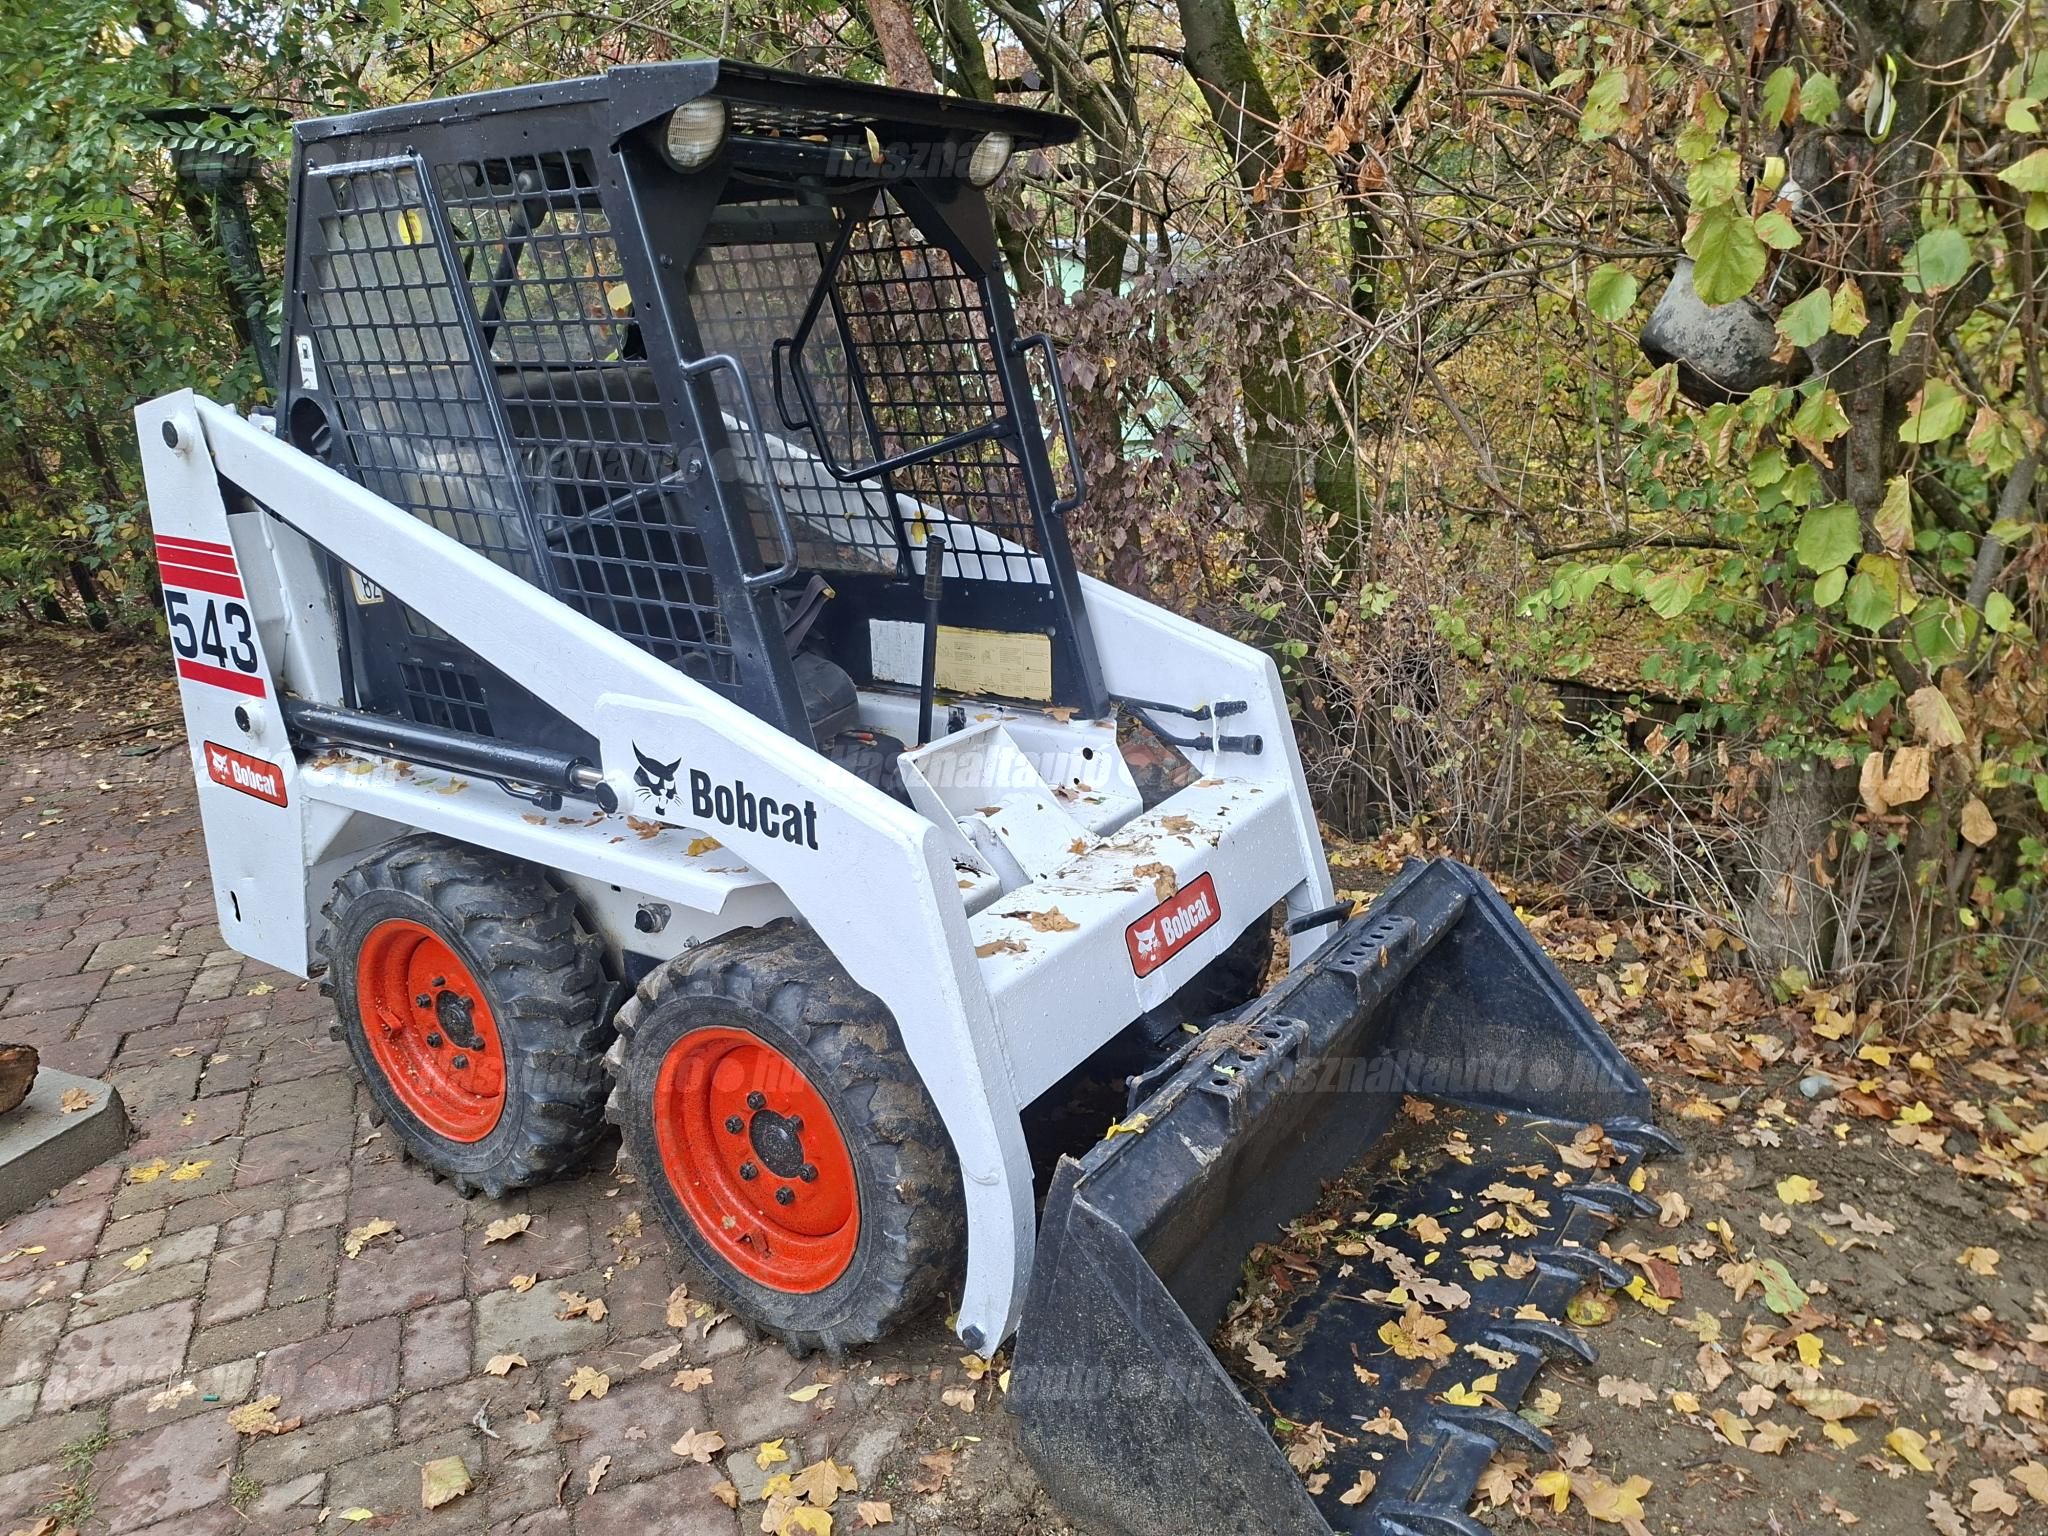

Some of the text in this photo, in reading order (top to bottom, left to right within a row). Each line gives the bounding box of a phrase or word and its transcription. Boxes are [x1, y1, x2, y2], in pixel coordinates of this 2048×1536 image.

[164, 589, 258, 674] 543
[231, 759, 278, 798] Bobcat
[690, 768, 819, 850] Bobcat
[1160, 891, 1212, 947] Bobcat
